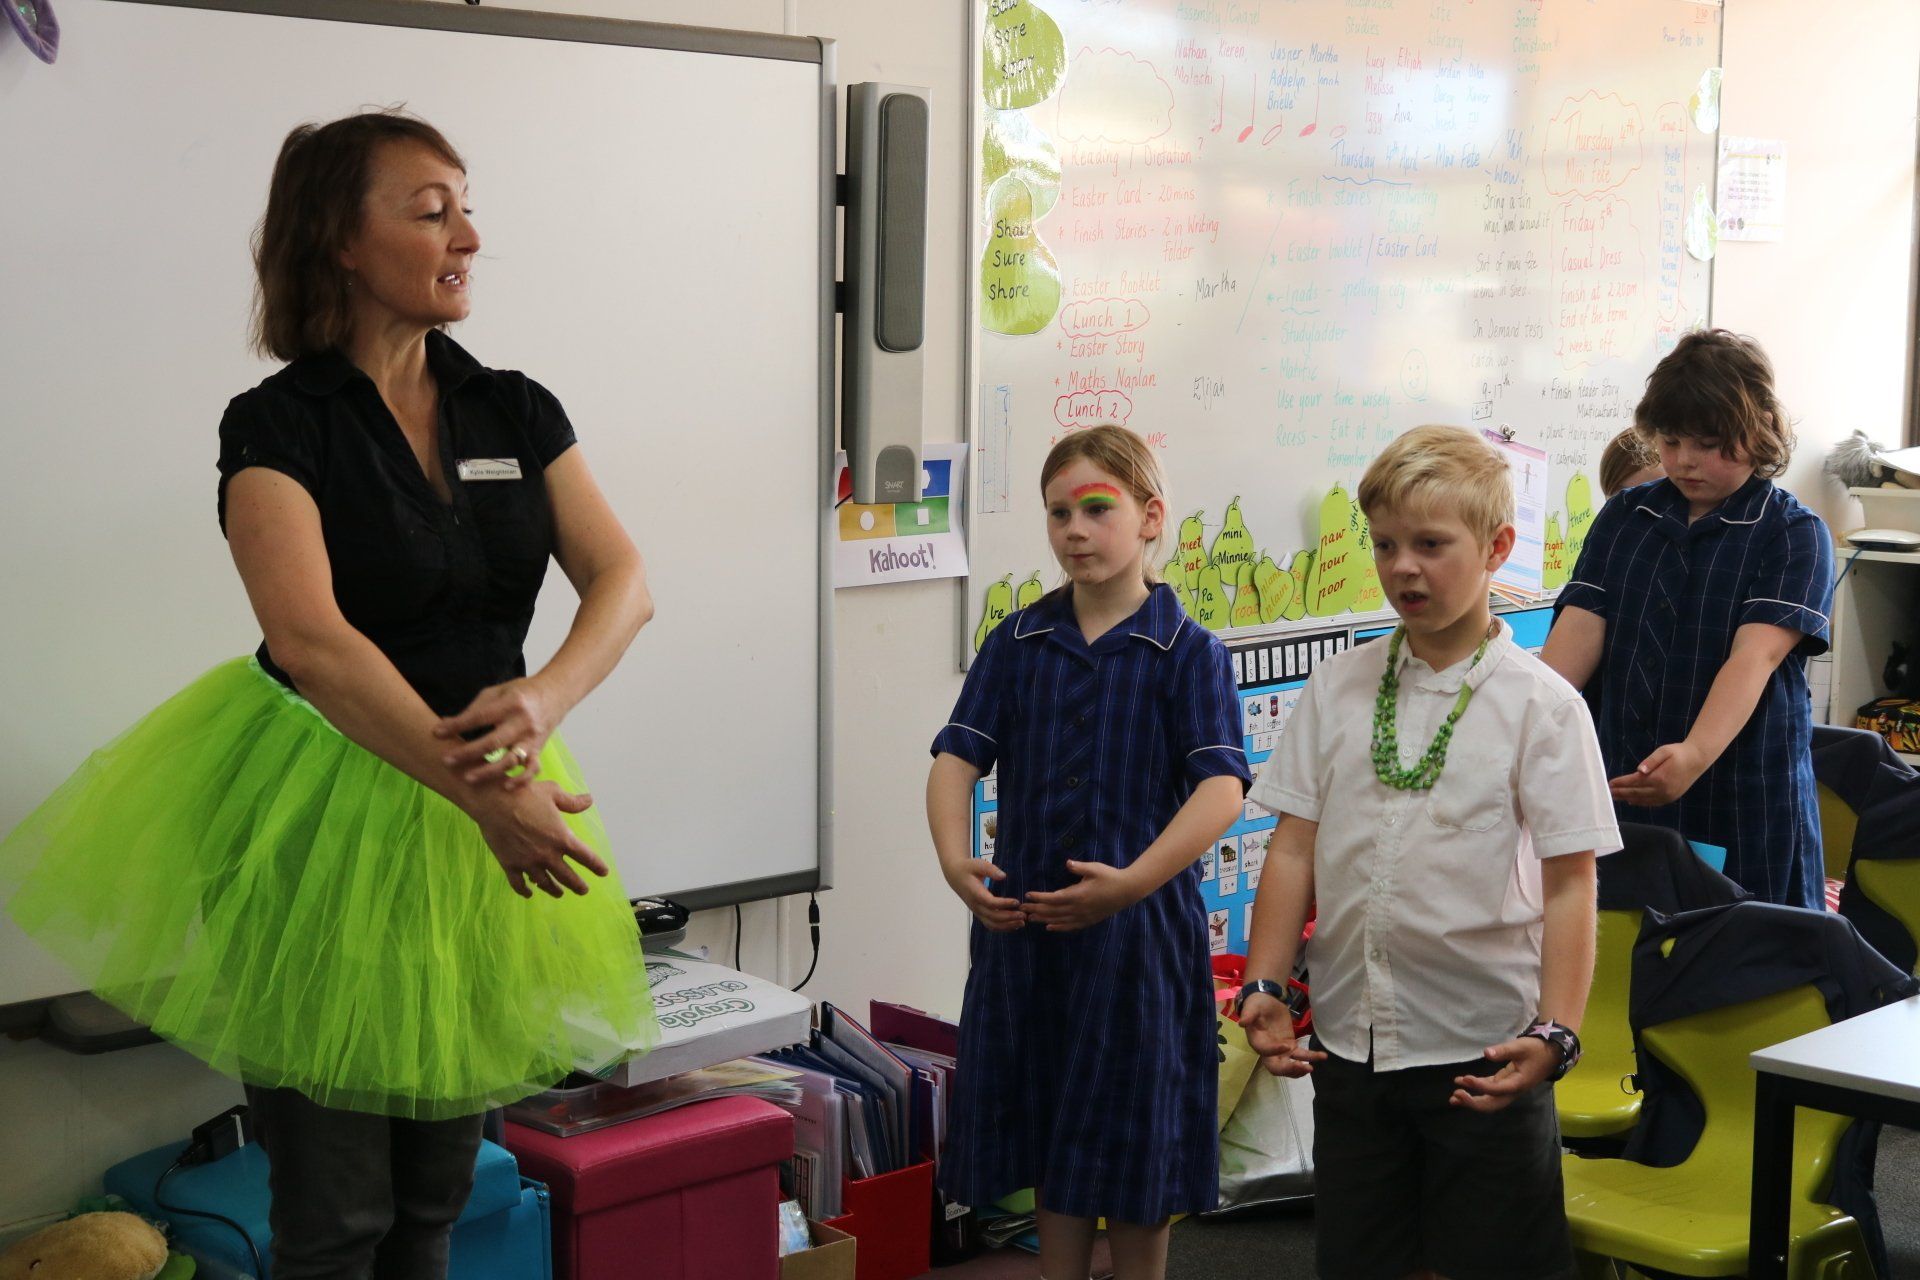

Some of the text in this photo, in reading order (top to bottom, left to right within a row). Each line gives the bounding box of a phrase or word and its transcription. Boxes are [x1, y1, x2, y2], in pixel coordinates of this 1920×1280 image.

[1071, 144, 1119, 177] Reading
[1072, 179, 1142, 209] Easter Card
[1073, 219, 1105, 244] Finish
[1376, 236, 1409, 259] Easter
[1415, 233, 1440, 259] Card
[1561, 246, 1624, 272] Casual Dress
[1072, 277, 1110, 297] Easter
[1195, 268, 1237, 303] Martha
[1073, 305, 1113, 330] Lunch
[1070, 334, 1145, 362] Easter Story
[1068, 366, 1157, 395] Maths Naplan
[1193, 375, 1225, 411] Elijah
[1067, 398, 1118, 419] Lunch 2
[1277, 389, 1294, 411] Use
[1298, 391, 1323, 422] your
[1223, 525, 1243, 540] mini
[1219, 545, 1249, 566] Minnie
[1202, 587, 1213, 604] Pa
[1200, 608, 1215, 625] Par
[658, 998, 756, 1029] Crayola
